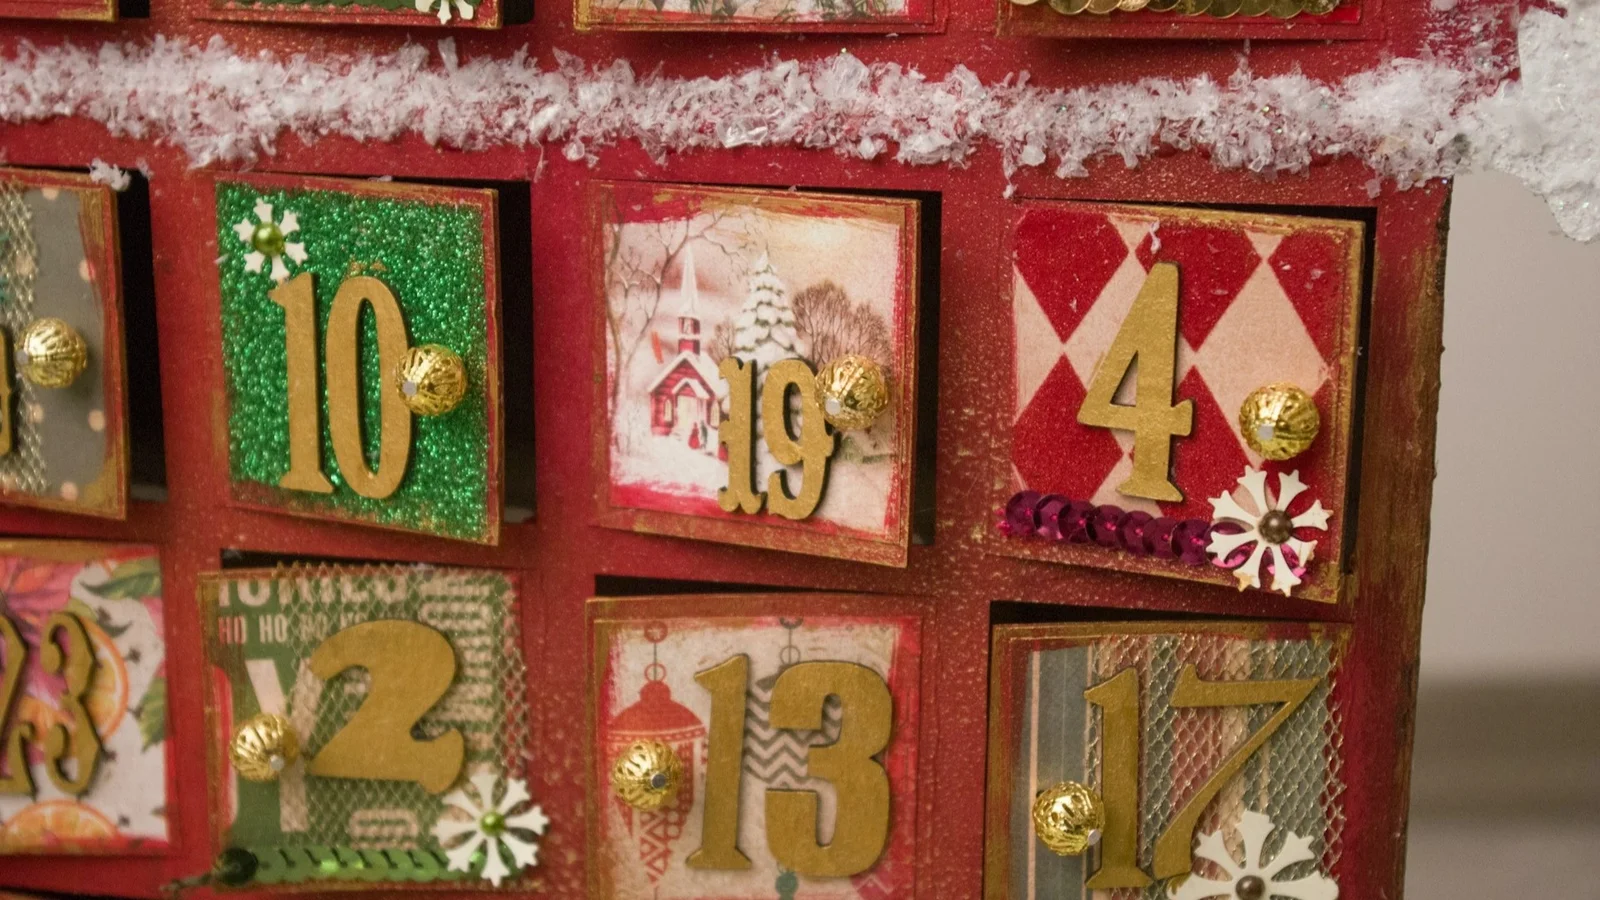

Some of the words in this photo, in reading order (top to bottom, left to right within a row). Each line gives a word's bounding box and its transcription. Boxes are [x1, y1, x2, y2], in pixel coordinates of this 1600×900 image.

[268, 270, 412, 499] 10
[717, 354, 841, 520] 19
[1077, 260, 1195, 503] 4
[259, 613, 289, 644] HO
[309, 618, 466, 795] 2
[685, 652, 893, 878] 13
[1083, 662, 1321, 893] 17
